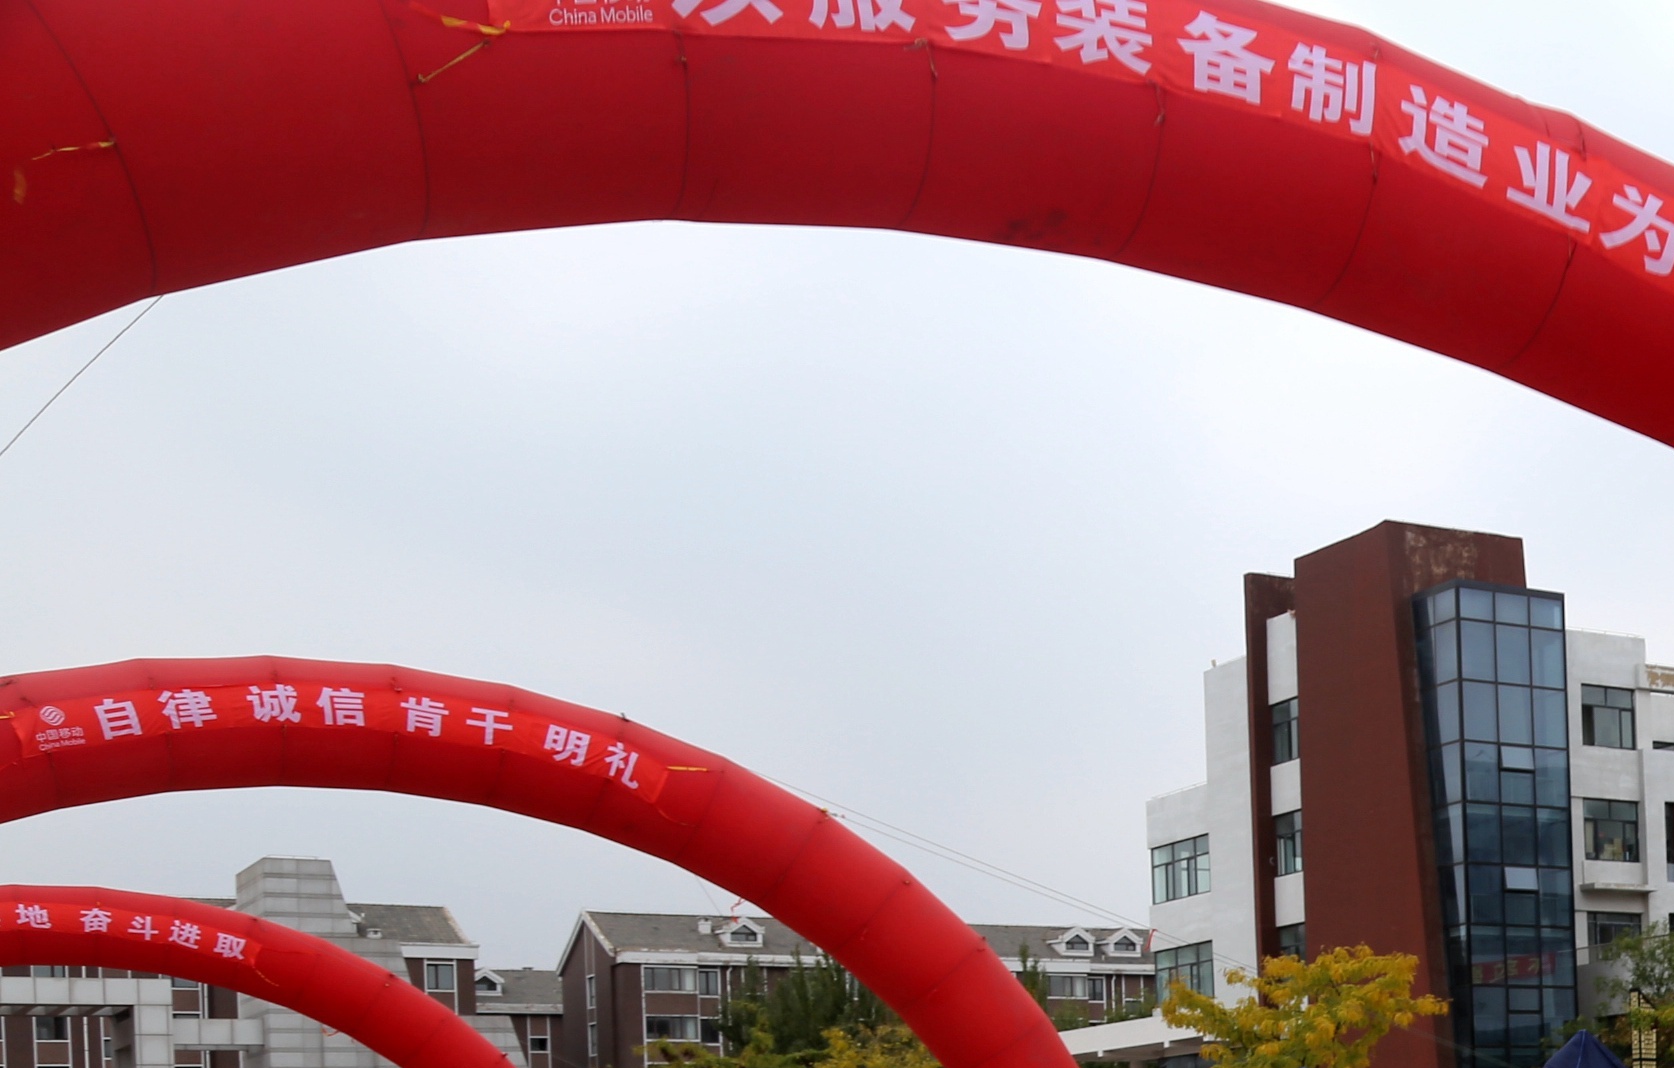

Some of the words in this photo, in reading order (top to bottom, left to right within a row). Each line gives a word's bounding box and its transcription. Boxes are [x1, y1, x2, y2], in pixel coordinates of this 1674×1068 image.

[549, 8, 597, 26] China
[600, 5, 654, 24] Mobile
[35, 726, 85, 744] 中国移动
[93, 688, 218, 741] 自律
[246, 684, 366, 727] 诚信
[400, 696, 514, 745] 肯干
[544, 723, 640, 790] 明礼
